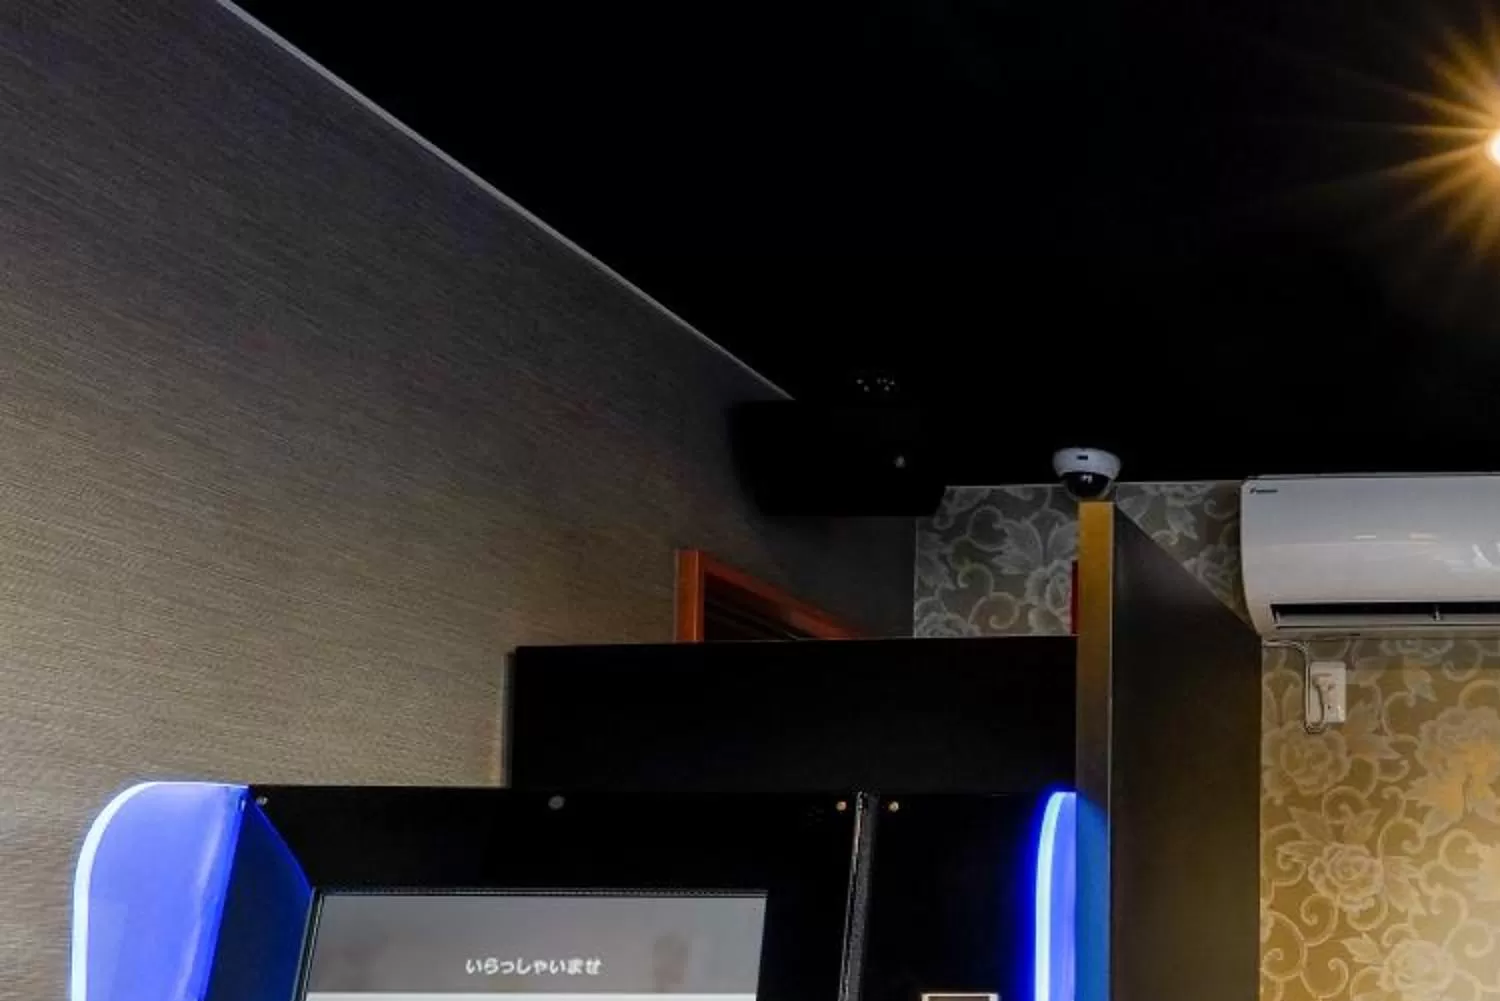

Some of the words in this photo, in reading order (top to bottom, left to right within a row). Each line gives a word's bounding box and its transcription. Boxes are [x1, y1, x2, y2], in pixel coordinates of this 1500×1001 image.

[465, 957, 602, 975] いらっしゃいませ
